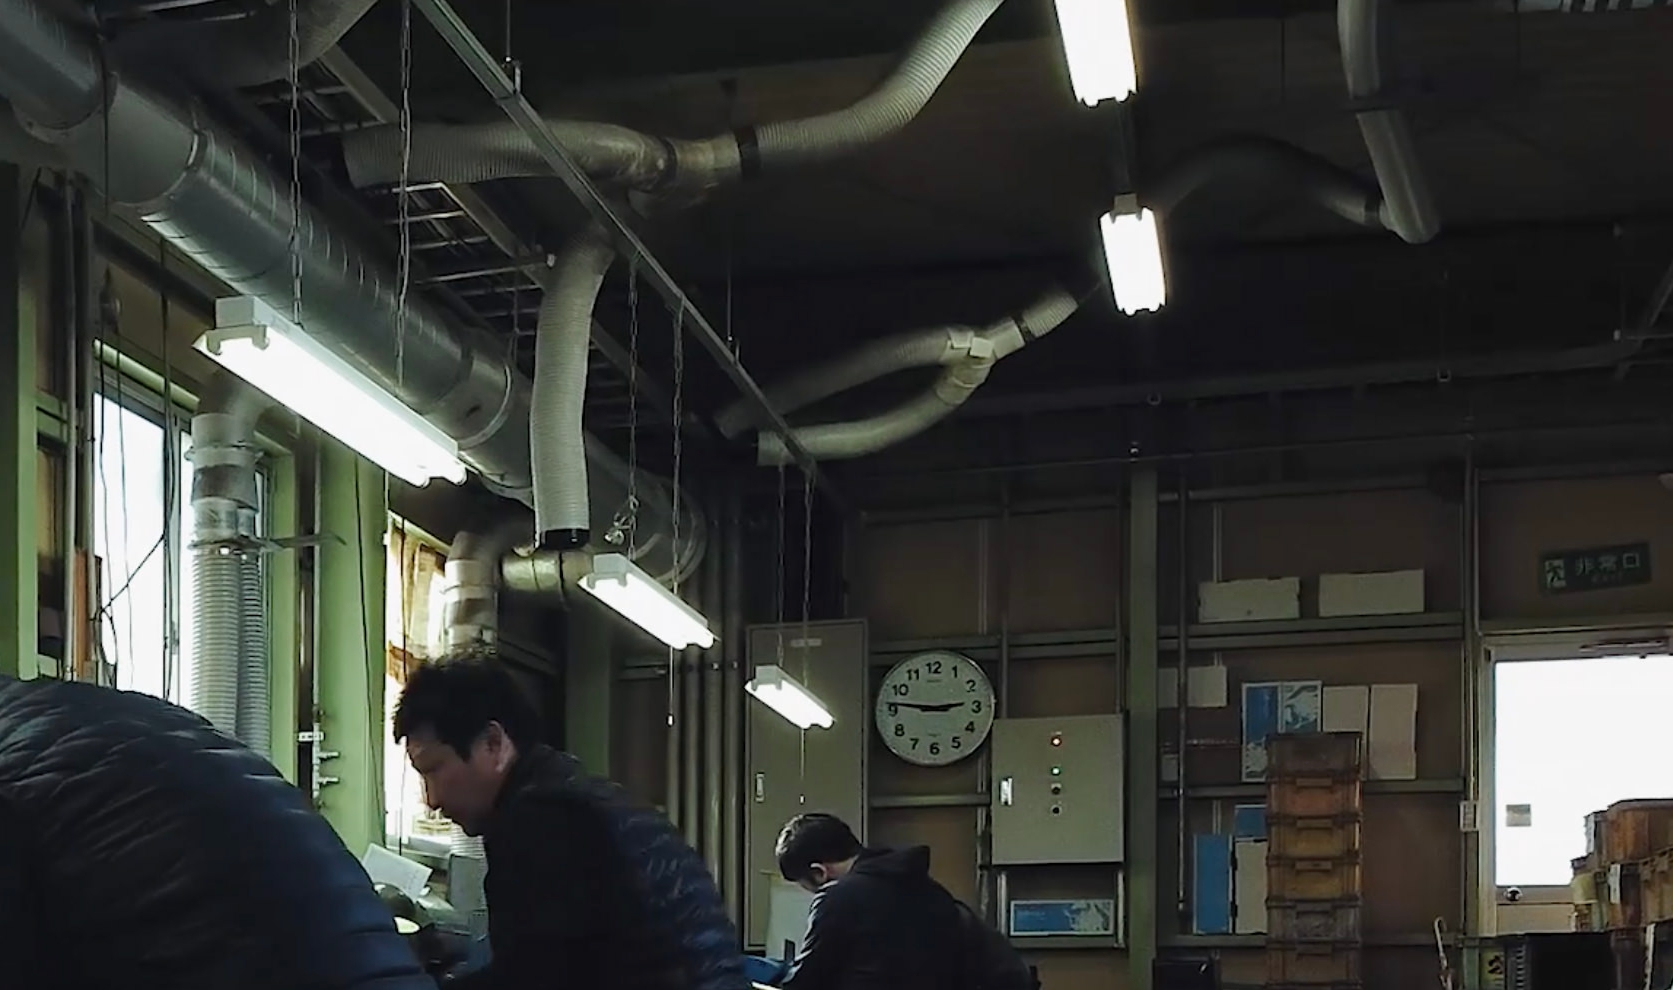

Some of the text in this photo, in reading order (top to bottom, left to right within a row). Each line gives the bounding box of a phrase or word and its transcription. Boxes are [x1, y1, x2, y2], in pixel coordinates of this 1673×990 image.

[926, 661, 942, 674] 12
[952, 666, 958, 678] 1
[907, 669, 920, 680] 11
[892, 684, 909, 696] 10
[966, 680, 977, 693] 2
[971, 700, 982, 713] 3
[894, 724, 905, 737] 8
[965, 721, 975, 733] 4
[910, 738, 919, 750] 7
[930, 743, 940, 755] 6
[951, 737, 961, 749] 5
